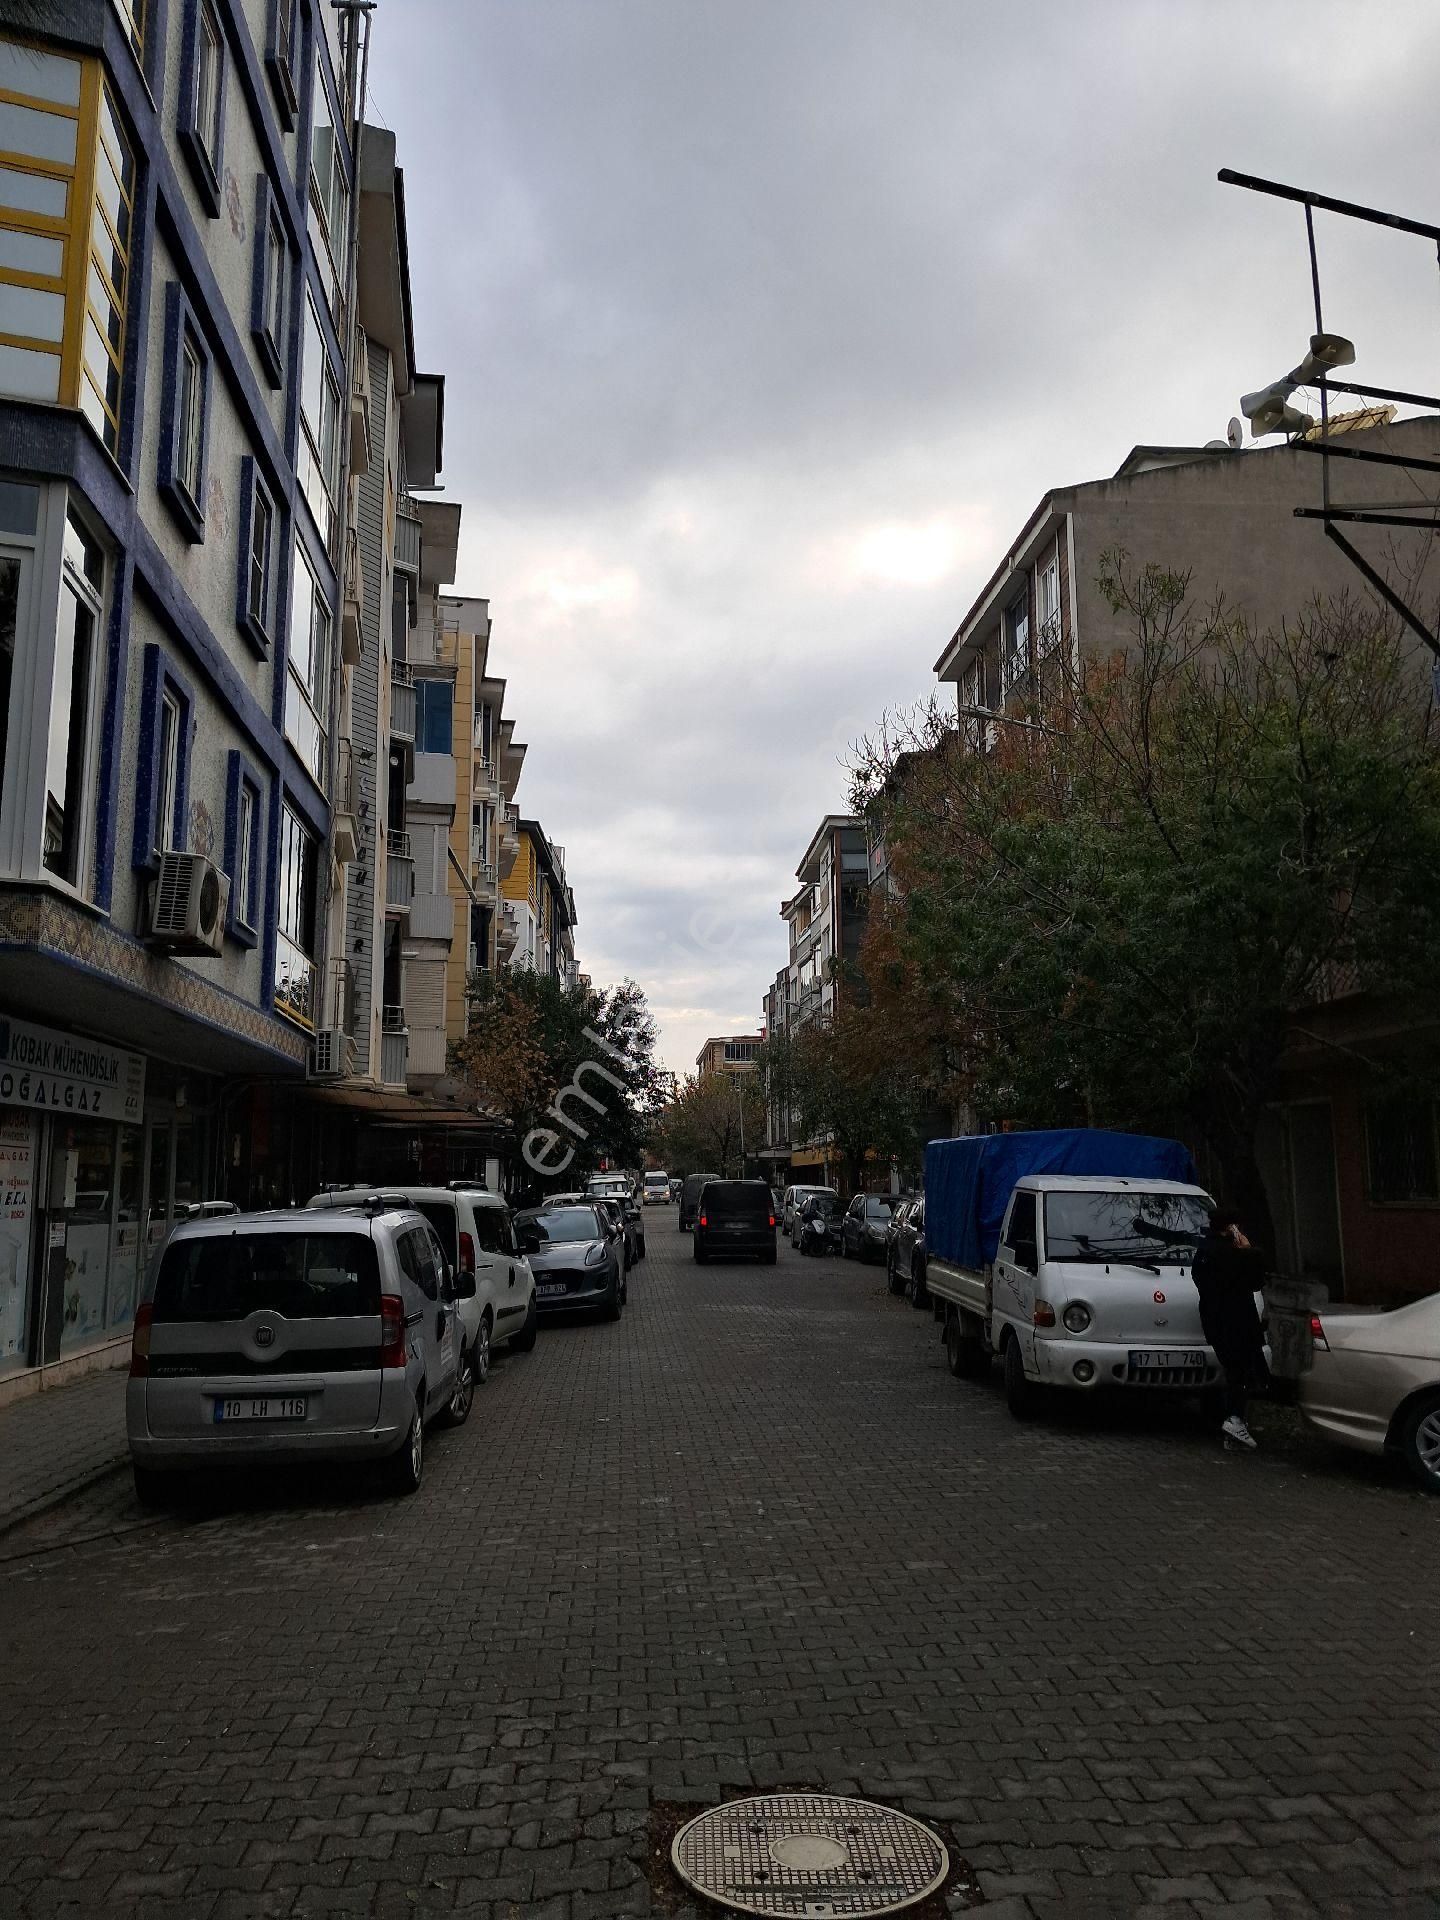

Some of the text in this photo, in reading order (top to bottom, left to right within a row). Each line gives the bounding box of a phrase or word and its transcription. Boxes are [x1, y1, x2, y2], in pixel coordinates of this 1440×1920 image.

[11, 1032, 51, 1068] KOBAK
[53, 1039, 119, 1083] MÜHENDİSLİK
[0, 1073, 101, 1112] OĞALGAZ
[0, 1151, 29, 1161] ALGAZ
[1138, 1353, 1203, 1366] 17 LT 740
[226, 1399, 303, 1417] 10 LH 116
